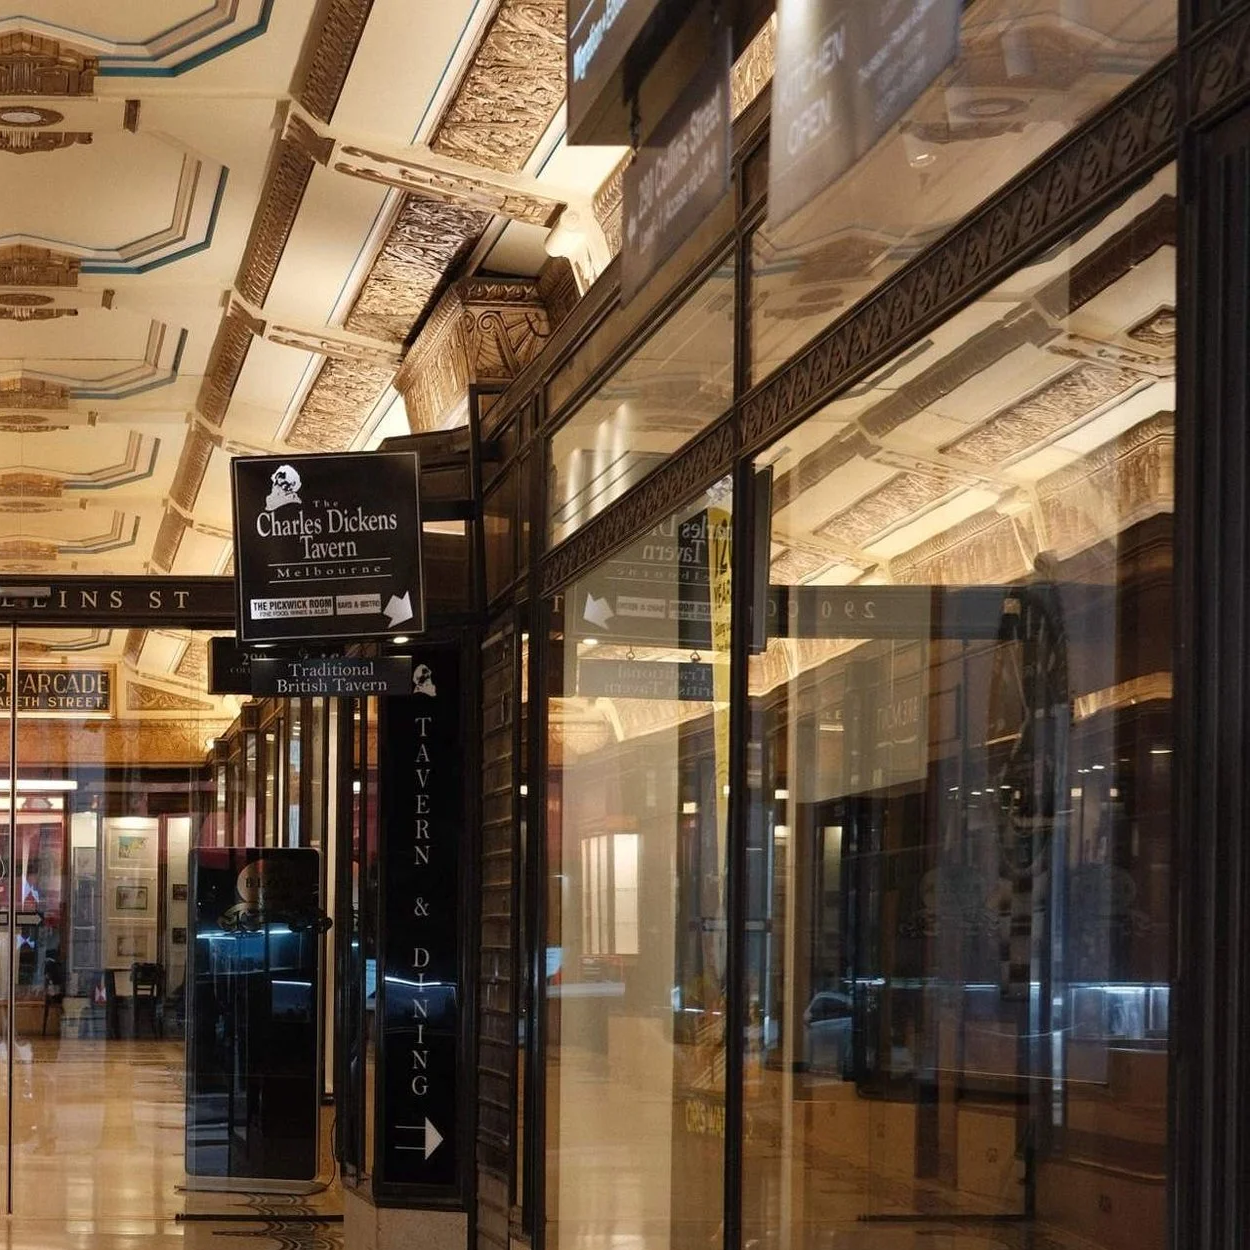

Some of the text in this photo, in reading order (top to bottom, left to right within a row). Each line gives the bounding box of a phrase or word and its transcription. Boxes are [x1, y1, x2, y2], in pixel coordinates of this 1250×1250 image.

[312, 499, 340, 508] The
[256, 507, 398, 538] Charles Dickens
[299, 535, 358, 560] Tavern
[276, 564, 382, 579] Melbourne
[148, 590, 192, 610] ST
[253, 599, 332, 612] THE PICKWICK ROOM
[288, 660, 374, 677] Traditional
[22, 673, 108, 694] ARCADE
[277, 677, 388, 694] British Tavern
[411, 718, 433, 1097] TAVERN & DINING
